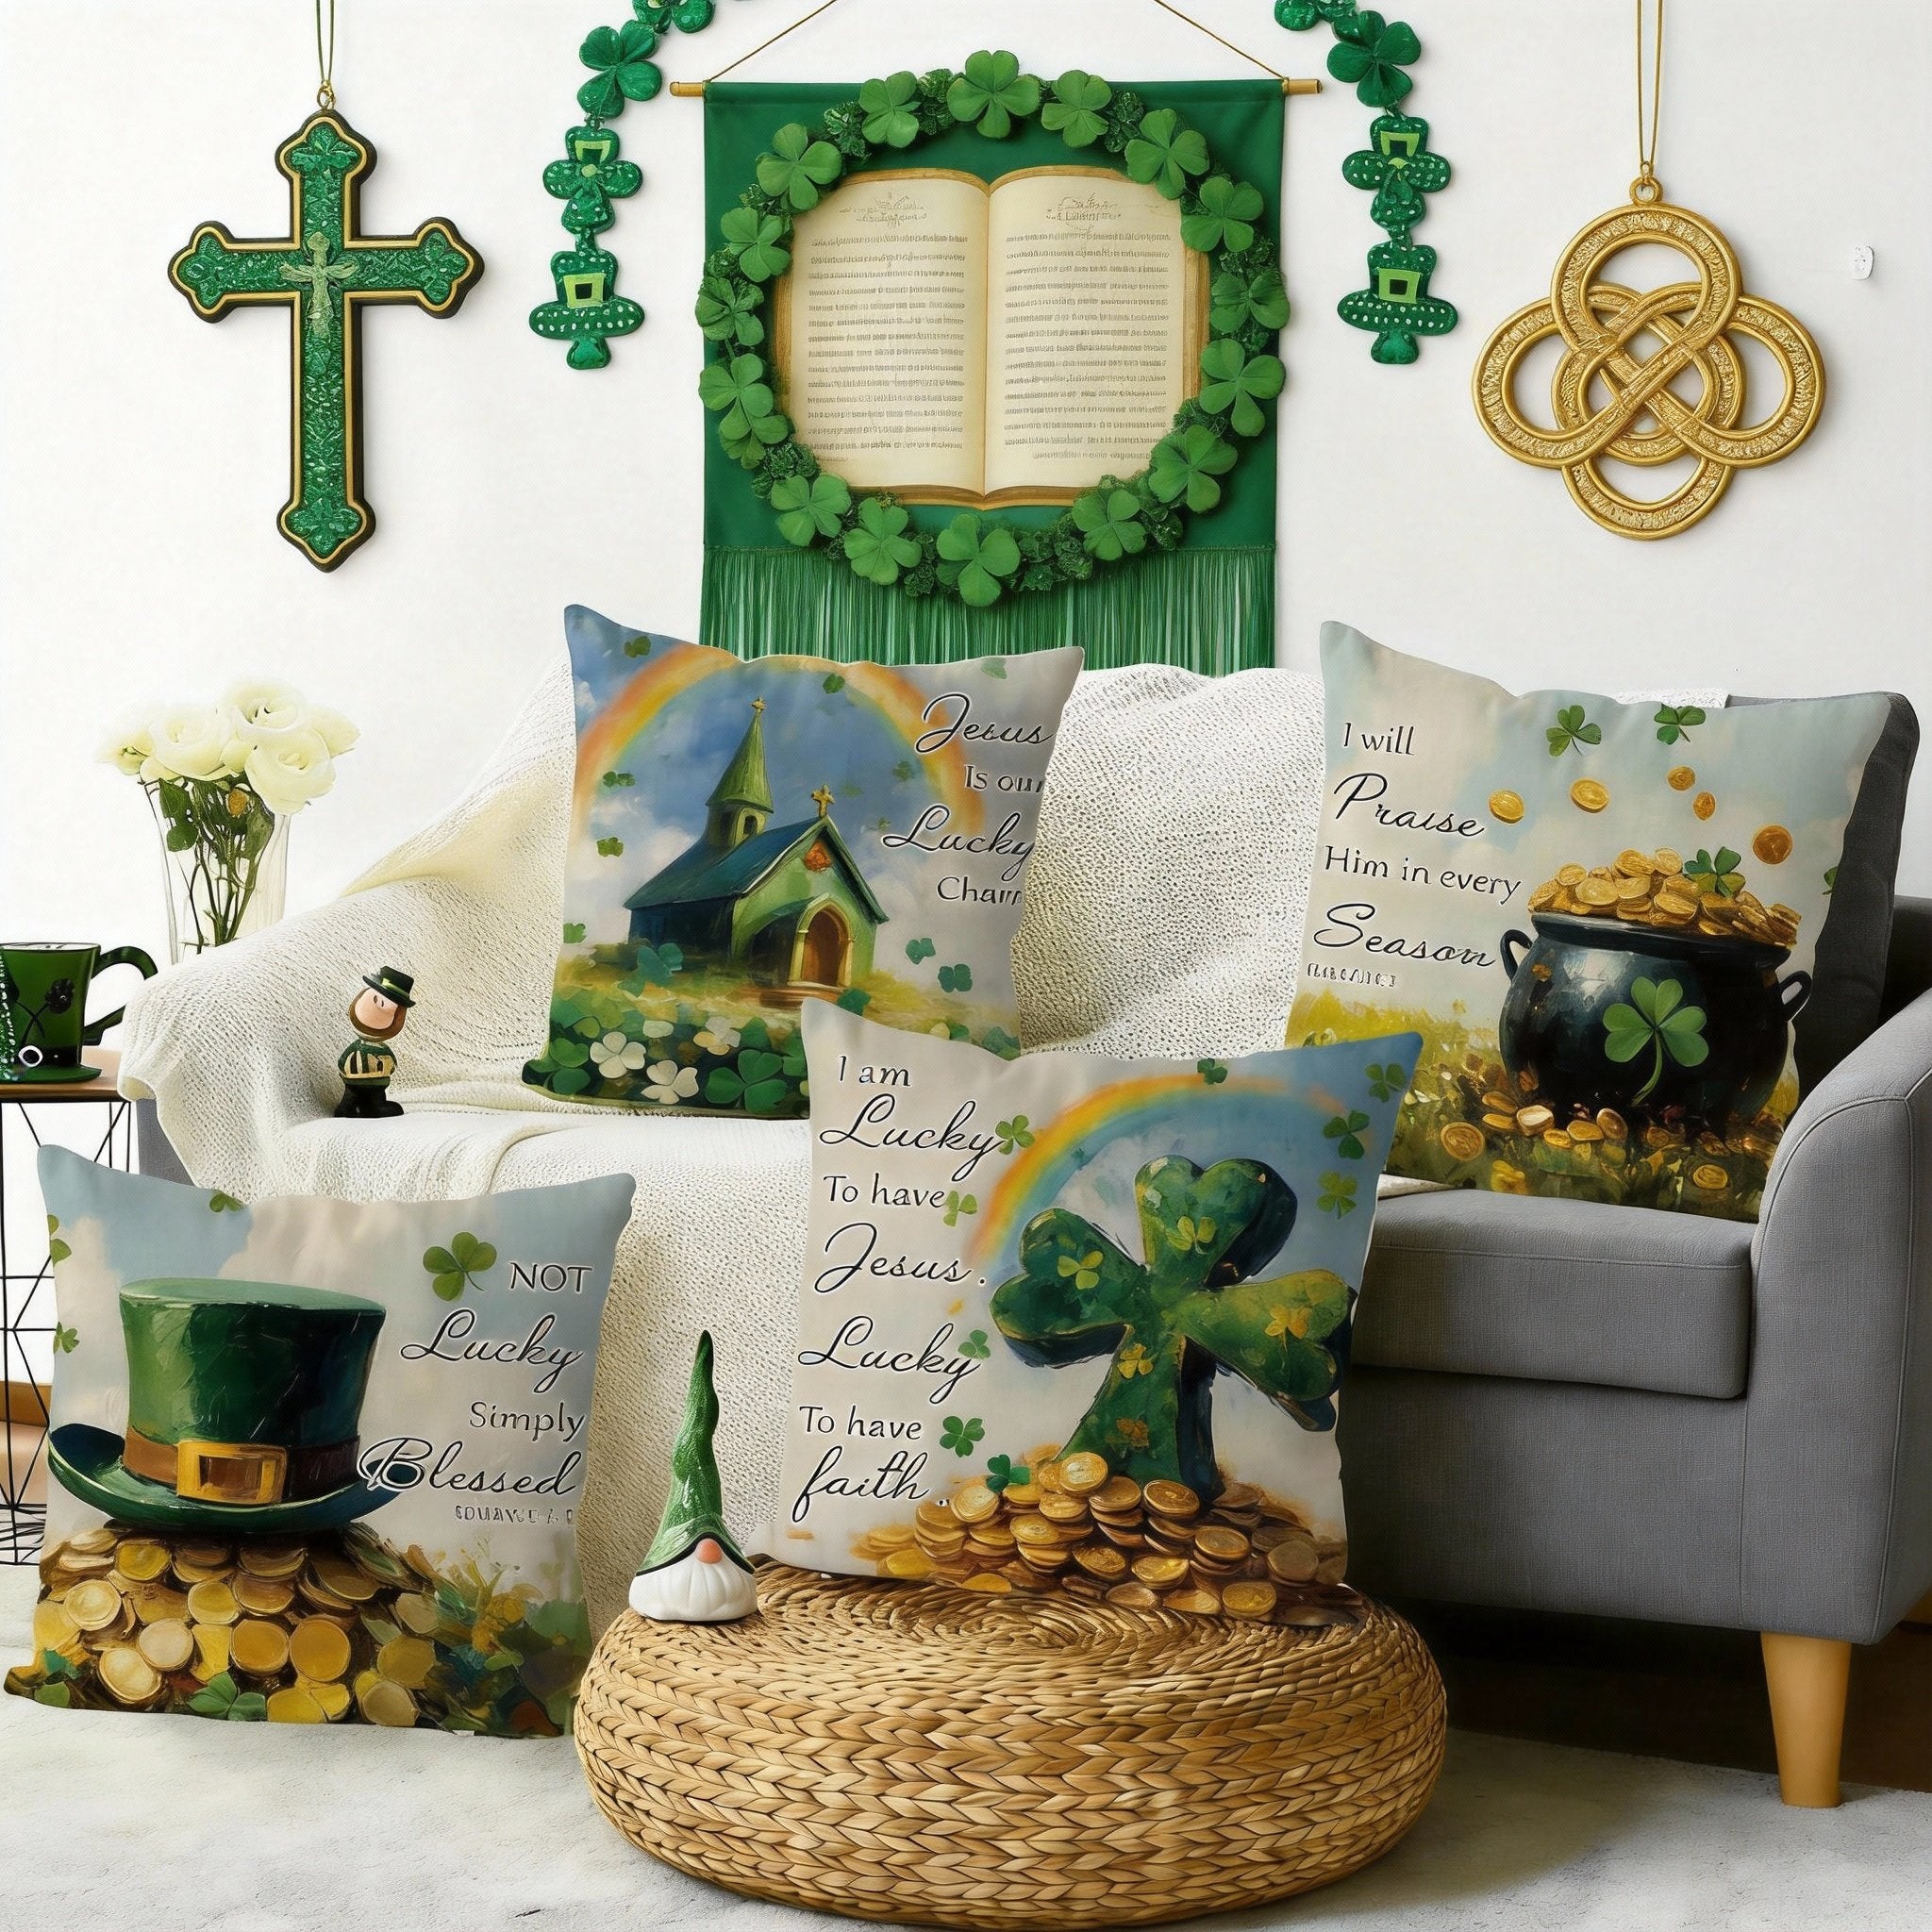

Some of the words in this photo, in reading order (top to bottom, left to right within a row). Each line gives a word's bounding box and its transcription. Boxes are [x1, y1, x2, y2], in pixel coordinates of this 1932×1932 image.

[915, 692, 1054, 754] Jesus
[1343, 722, 1352, 747] I
[1361, 725, 1415, 756] will
[965, 765, 988, 790] Is
[1333, 772, 1486, 838] Praise
[882, 804, 1036, 882] Lucky
[1324, 845, 1389, 878] Him
[1402, 857, 1431, 885] in
[1440, 869, 1522, 906] every
[1313, 903, 1496, 968] Season
[839, 1055, 847, 1082] I
[858, 1066, 911, 1087] am
[819, 1093, 1004, 1182] Lucky
[823, 1175, 858, 1203] To
[872, 1173, 945, 1208] have
[508, 1261, 593, 1293] NOT
[400, 1308, 584, 1394] Lucky
[797, 1315, 982, 1405] Lucky
[470, 1401, 585, 1442] Simply
[799, 1406, 835, 1433] To
[847, 1405, 922, 1441] have
[358, 1437, 582, 1496] Blessed
